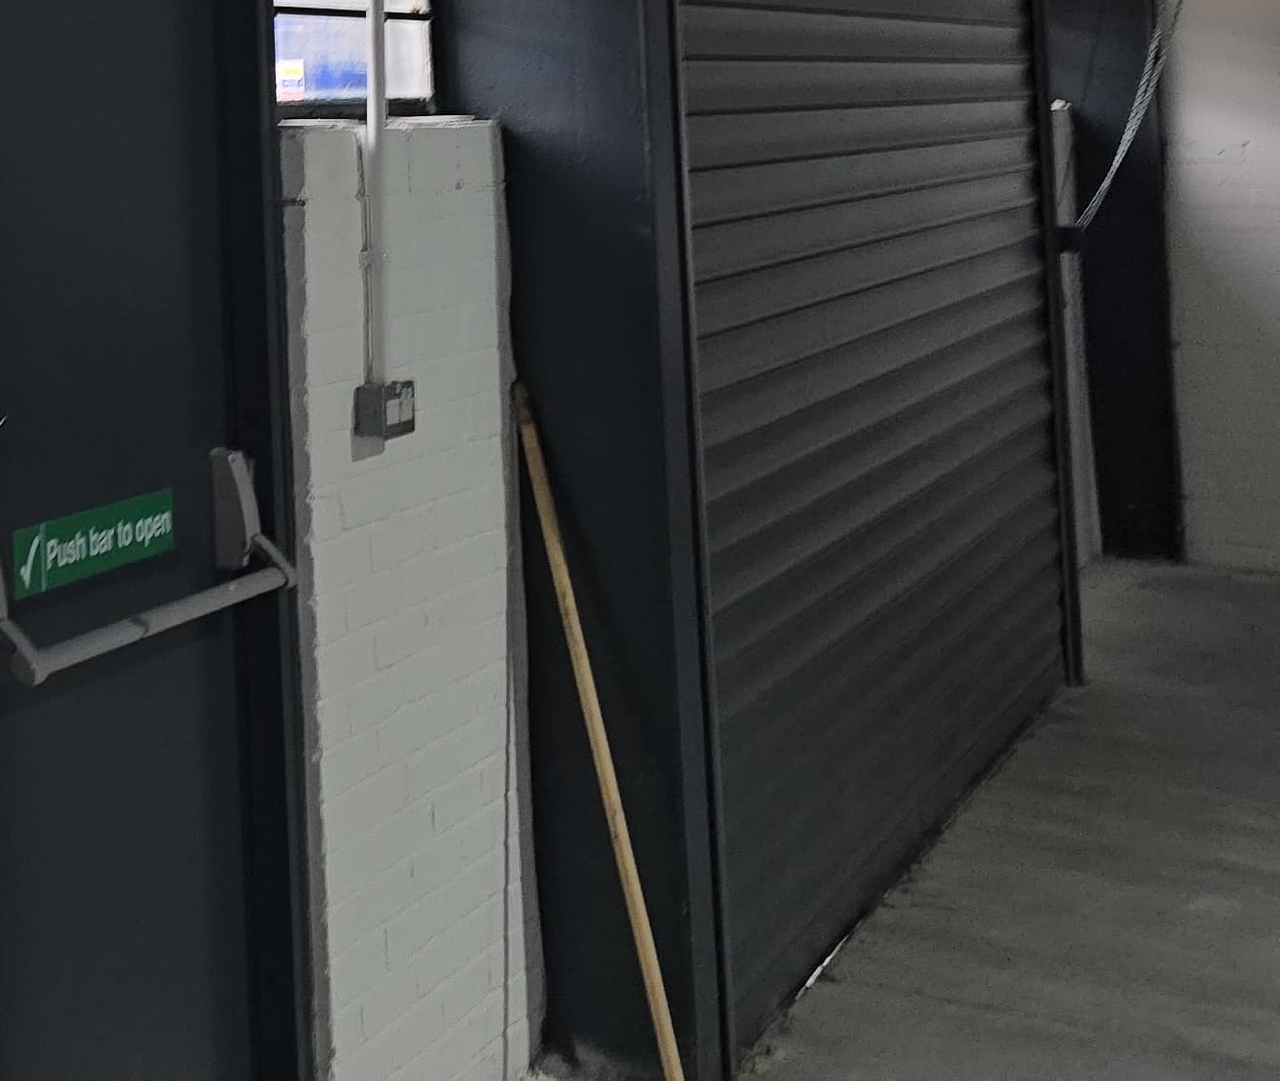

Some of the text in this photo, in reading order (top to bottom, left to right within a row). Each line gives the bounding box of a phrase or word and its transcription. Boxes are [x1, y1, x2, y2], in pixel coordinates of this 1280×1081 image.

[46, 511, 172, 571] Push bar to open
